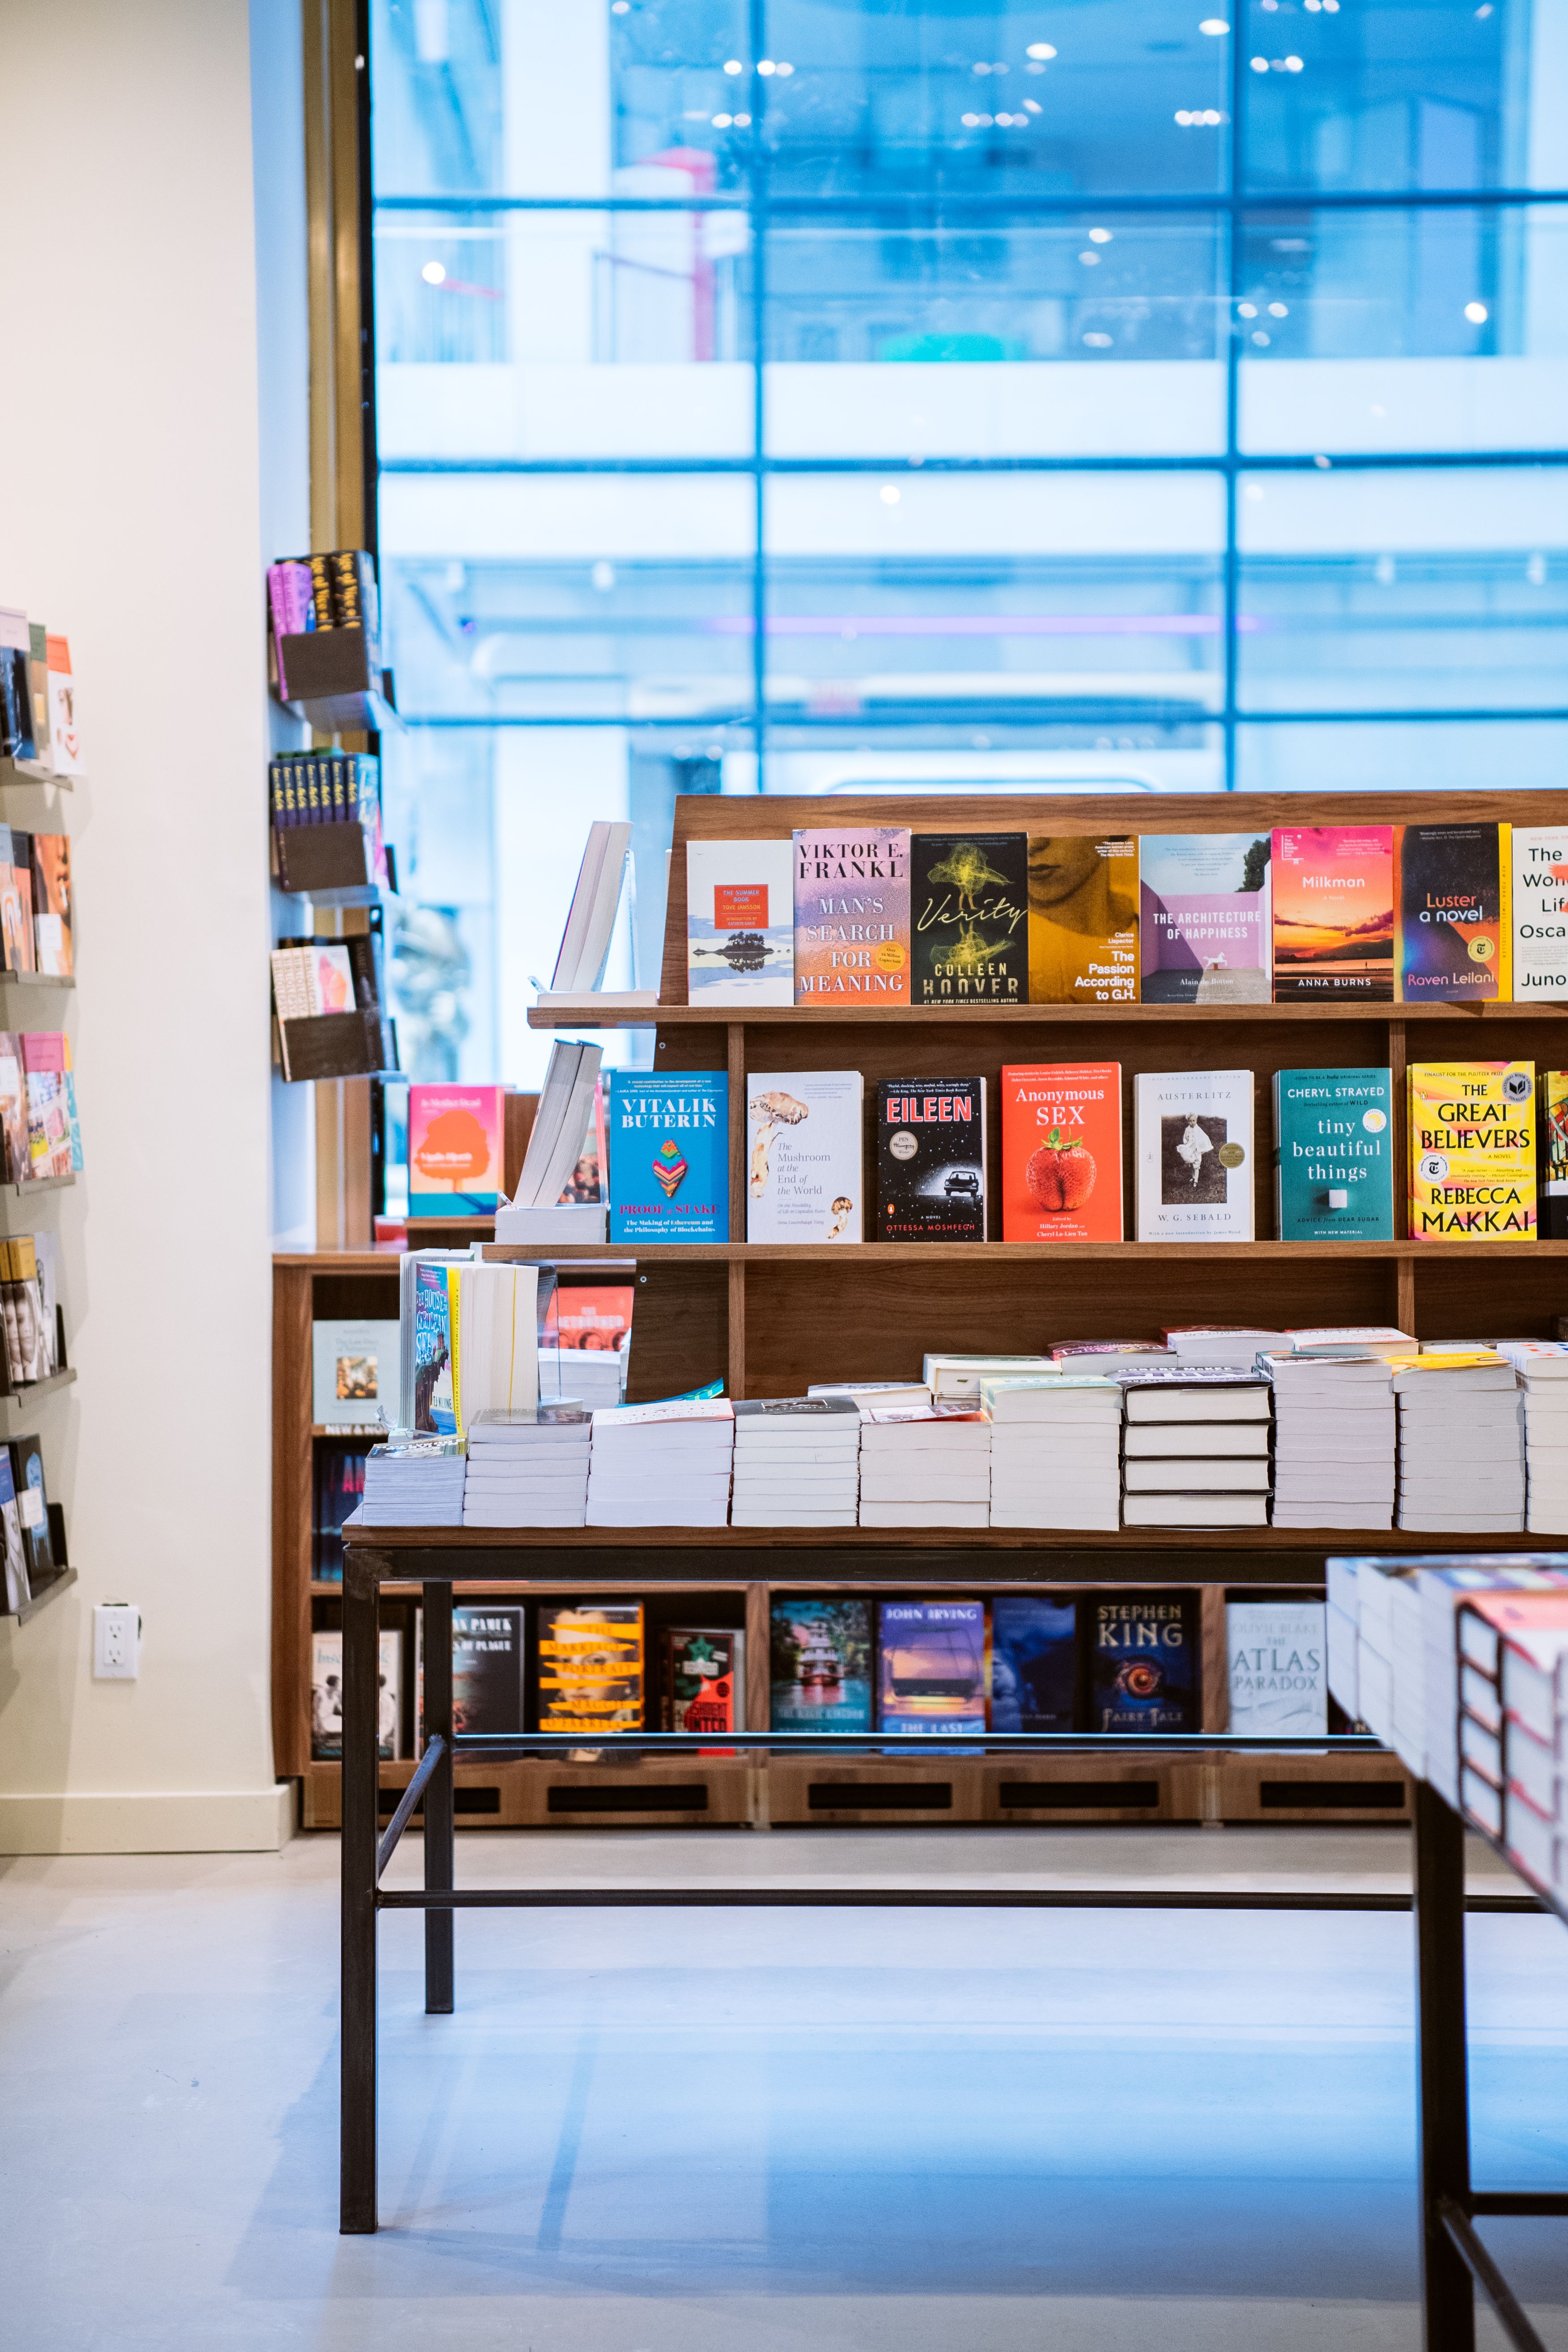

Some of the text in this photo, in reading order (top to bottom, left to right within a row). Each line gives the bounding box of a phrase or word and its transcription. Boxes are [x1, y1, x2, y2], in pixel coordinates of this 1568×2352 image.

[799, 843, 903, 858] VIKTOR E.
[1529, 848, 1562, 862] The
[799, 861, 903, 879] FRANKL
[1302, 877, 1366, 888] Milkman
[818, 897, 883, 914] MAN’S
[1427, 893, 1476, 909] Luster
[918, 894, 1028, 934] Verity
[1153, 911, 1261, 924] THE ARCHITECTURE
[1419, 906, 1483, 922] a novel
[807, 924, 895, 941] SEARCH
[1167, 927, 1248, 939] OF HAPPINESS
[1520, 925, 1568, 938] Osca
[831, 951, 871, 967] FOR
[1111, 951, 1134, 961] The
[935, 963, 1007, 976] COLLEEN
[1089, 963, 1134, 974] Passion
[799, 975, 904, 991] MEANING
[1075, 976, 1134, 989] According
[1334, 978, 1372, 986] BURNS
[1408, 971, 1494, 986] Raven Leilani
[1521, 973, 1566, 986] Juno
[923, 978, 1018, 995] HOOVER
[1096, 989, 1136, 1000] to G.H.
[1462, 1084, 1488, 1096] THE
[1504, 1075, 1514, 1093] NATIONAL
[1016, 1088, 1104, 1104] Anonymous
[1158, 1092, 1231, 1100] AUSTERLITZ
[1288, 1087, 1384, 1098] CHERYL STRAYED
[622, 1098, 717, 1113] VITALIK
[887, 1097, 971, 1122] EILEEN
[1438, 1103, 1511, 1122] GREAT
[621, 1114, 716, 1128] BUTERIN
[1037, 1106, 1085, 1125] SEX
[1318, 1119, 1355, 1137] tiny
[778, 1142, 792, 1150] The
[1421, 1129, 1530, 1149] BELIEVERS
[1292, 1140, 1381, 1157] beautiful
[778, 1153, 830, 1162] Mushroom
[787, 1164, 799, 1172] the
[1308, 1164, 1367, 1182] things
[778, 1175, 808, 1185] End of
[778, 1185, 822, 1194] the World
[1431, 1187, 1522, 1204] REBECCA
[620, 1205, 664, 1215] PROOF
[675, 1204, 719, 1215] STAKE
[1422, 1211, 1529, 1232] MAKKAI
[424, 1289, 444, 1312] HOUSE
[417, 1310, 447, 1334] CERULEAN
[433, 1396, 452, 1409] TJ KLUNE
[885, 1608, 977, 1620] JOHN IRVING
[1097, 1605, 1182, 1620] STEPHEN
[1098, 1623, 1183, 1647] KING
[1231, 1648, 1320, 1672] ATLAS
[562, 1663, 632, 1674] PORTRAIT
[1232, 1676, 1317, 1691] PARADOX
[1101, 1707, 1183, 1733] FAIRY TALE
